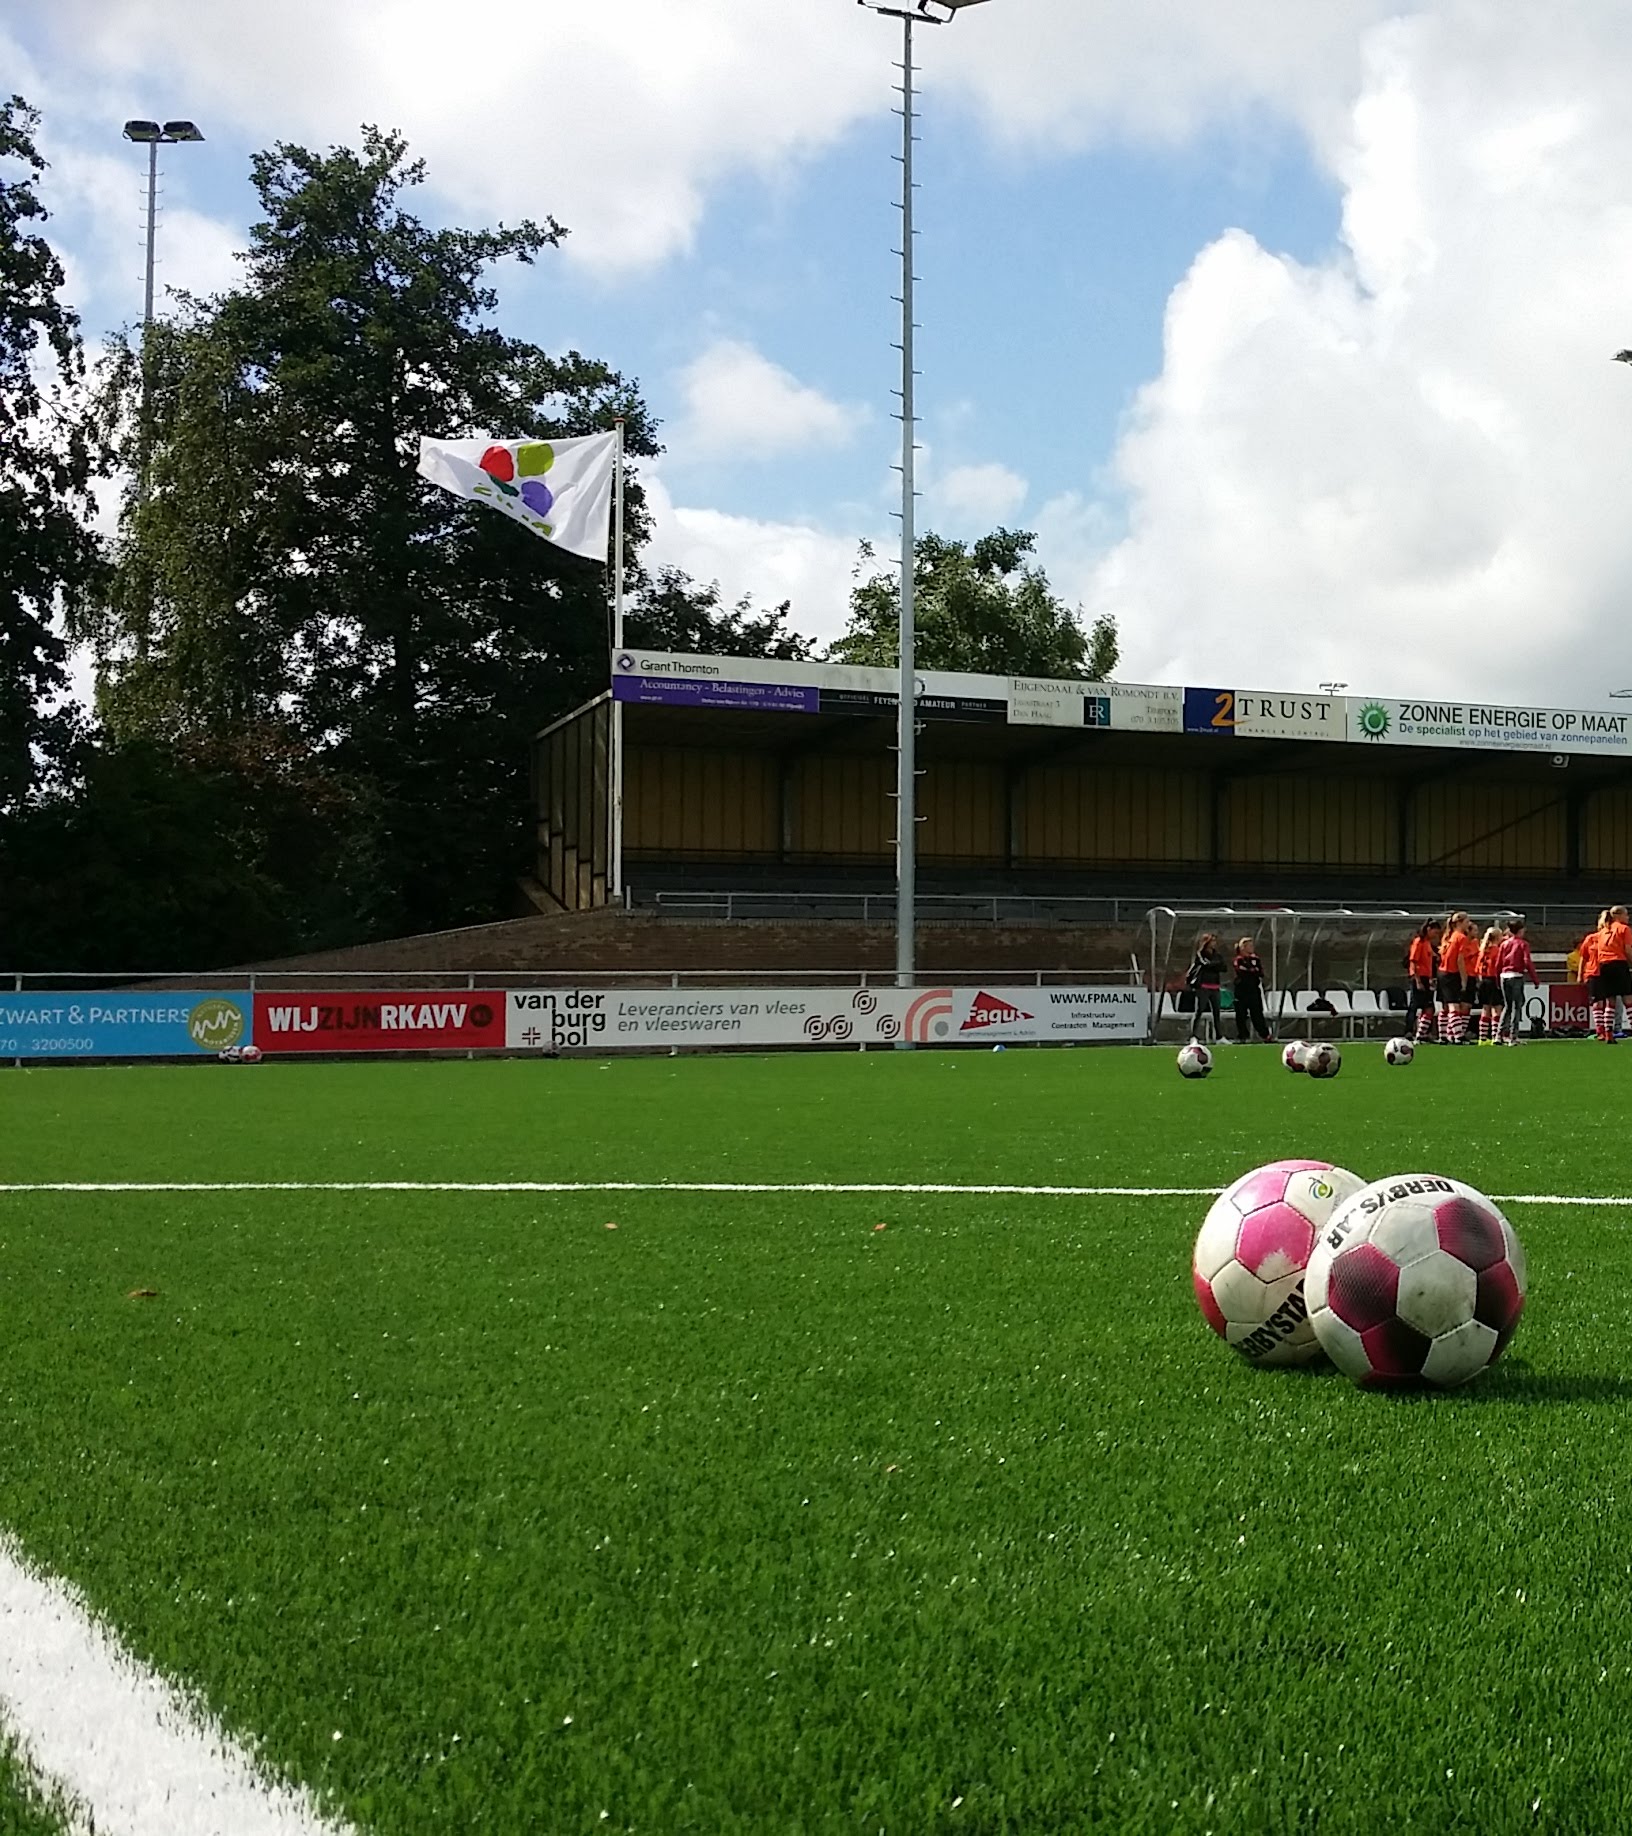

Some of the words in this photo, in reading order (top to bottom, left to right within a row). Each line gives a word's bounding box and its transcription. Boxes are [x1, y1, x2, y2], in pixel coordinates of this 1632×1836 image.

[640, 659, 671, 673] Grant
[672, 661, 720, 675] Thornton
[639, 678, 703, 695] Accountancy
[712, 682, 765, 698] Belastingen
[773, 686, 805, 699] Advies
[1075, 684, 1085, 696] &
[919, 699, 957, 710] AMATEUR
[1238, 697, 1331, 721] TRUST
[1399, 703, 1464, 724] ZONNE
[1469, 708, 1547, 729] ENERGIE
[1551, 713, 1577, 730] OP
[1581, 714, 1628, 733] MAAT
[1399, 723, 1414, 734] De
[1416, 724, 1466, 738] specialist
[1468, 729, 1482, 741] op
[1484, 727, 1501, 739] het
[1503, 729, 1538, 742] gebied
[1540, 732, 1558, 742] van
[1560, 734, 1628, 746] zonnepanelen
[1604, 930, 1614, 947] 7
[513, 994, 556, 1010] van
[564, 990, 606, 1010] der
[618, 1000, 724, 1017] Leveranciers
[730, 1001, 760, 1015] van
[765, 1000, 807, 1015] vlees
[1050, 993, 1137, 1005] WWW.FPMA.NL
[67, 1004, 85, 1025] &
[89, 1007, 190, 1024] PARTNERS
[551, 1009, 607, 1032] burg
[964, 1005, 1026, 1024] Fagus
[1551, 1001, 1588, 1023] bka
[617, 1020, 638, 1032] en
[644, 1017, 742, 1031] vleeswaren
[31, 1038, 94, 1051] 3200500
[551, 1027, 588, 1046] bol
